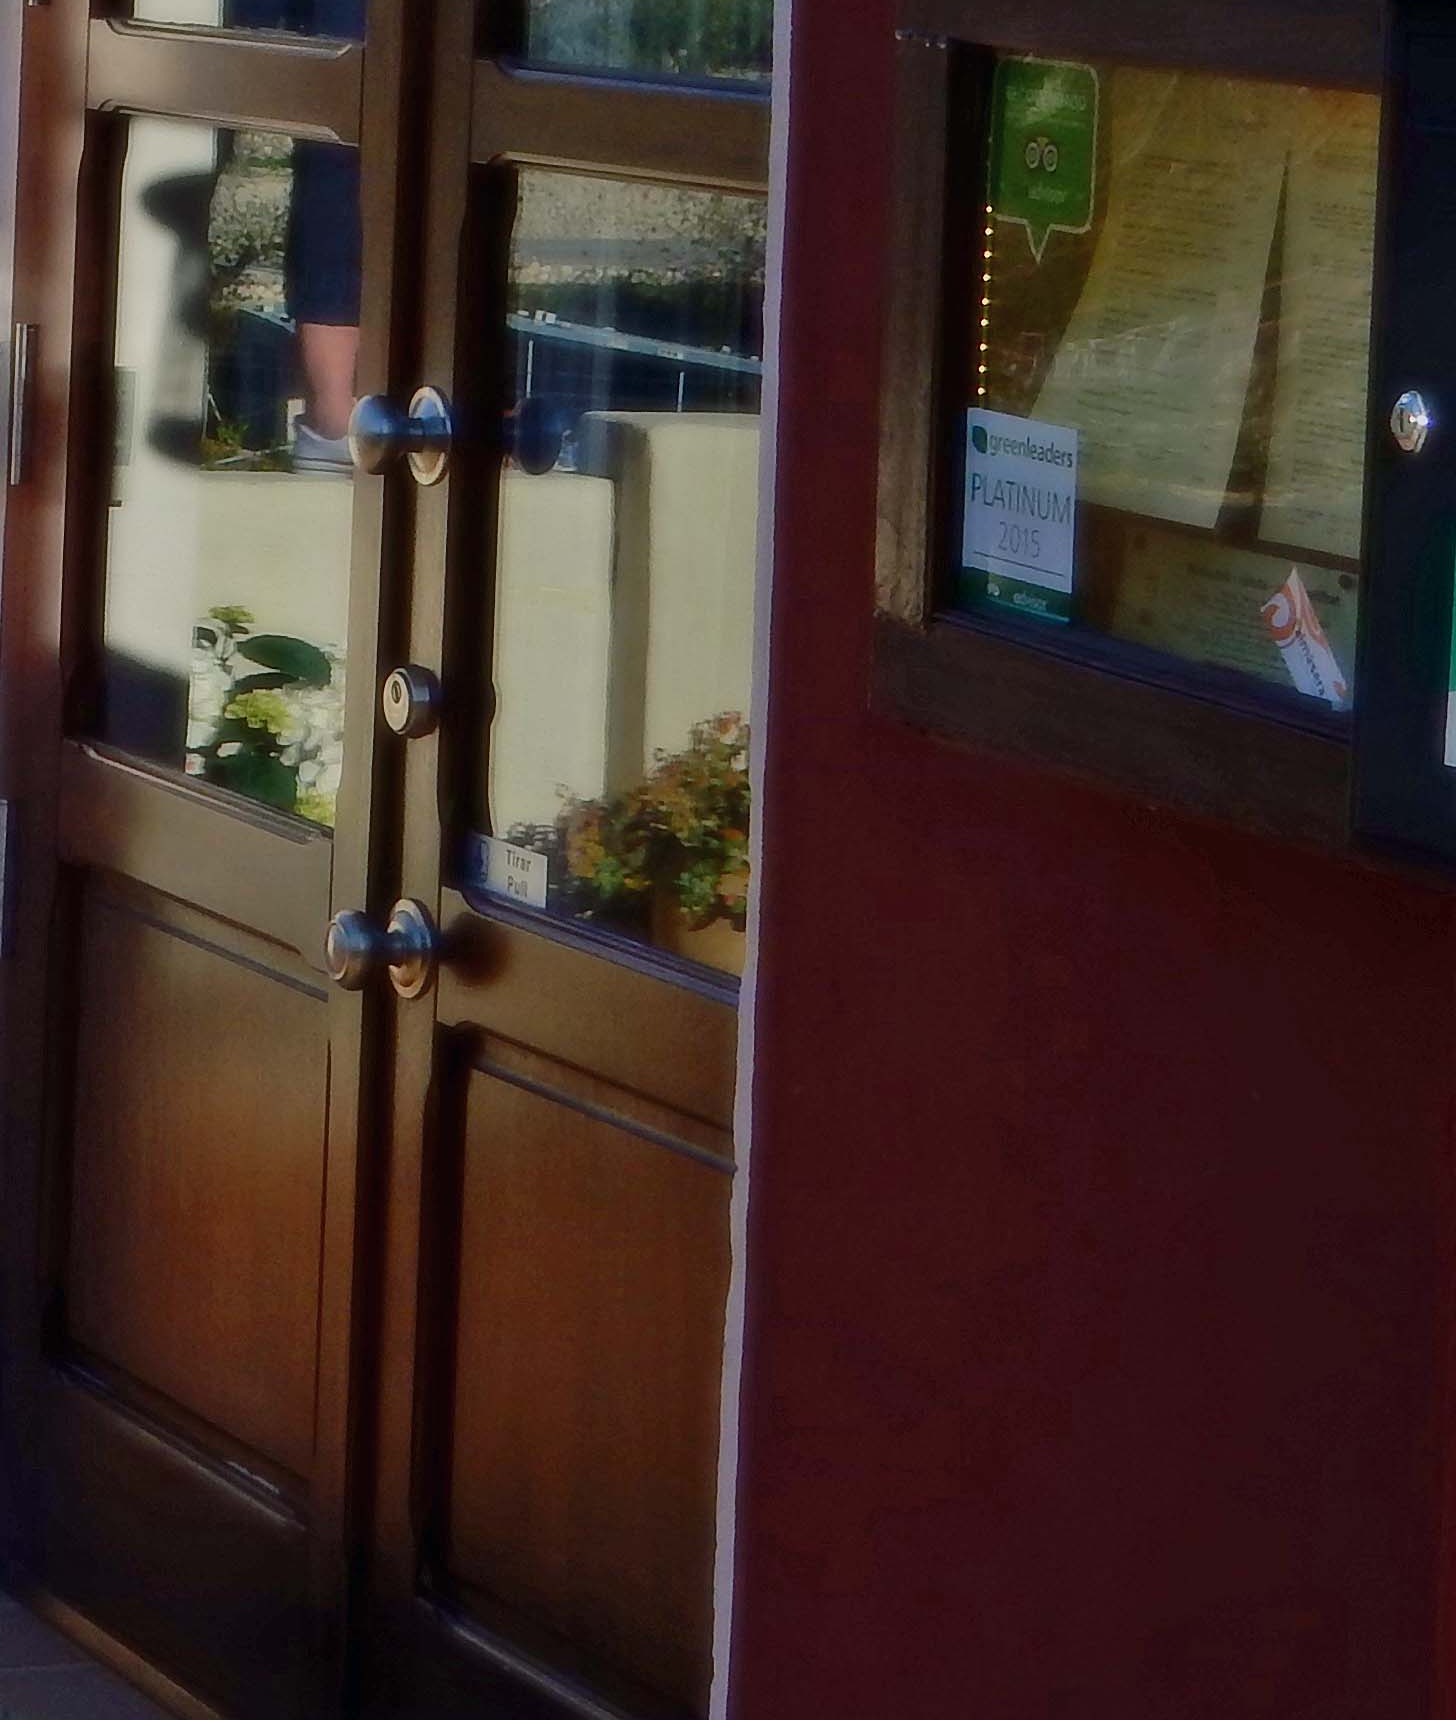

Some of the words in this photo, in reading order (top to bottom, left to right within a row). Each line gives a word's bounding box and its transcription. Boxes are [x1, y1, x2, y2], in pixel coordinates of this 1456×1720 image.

[989, 433, 1073, 468] greenleaders
[971, 473, 1072, 524] PLATINUM
[998, 521, 1041, 558] 2015
[506, 849, 532, 873] Tirar
[507, 875, 528, 898] Pull
